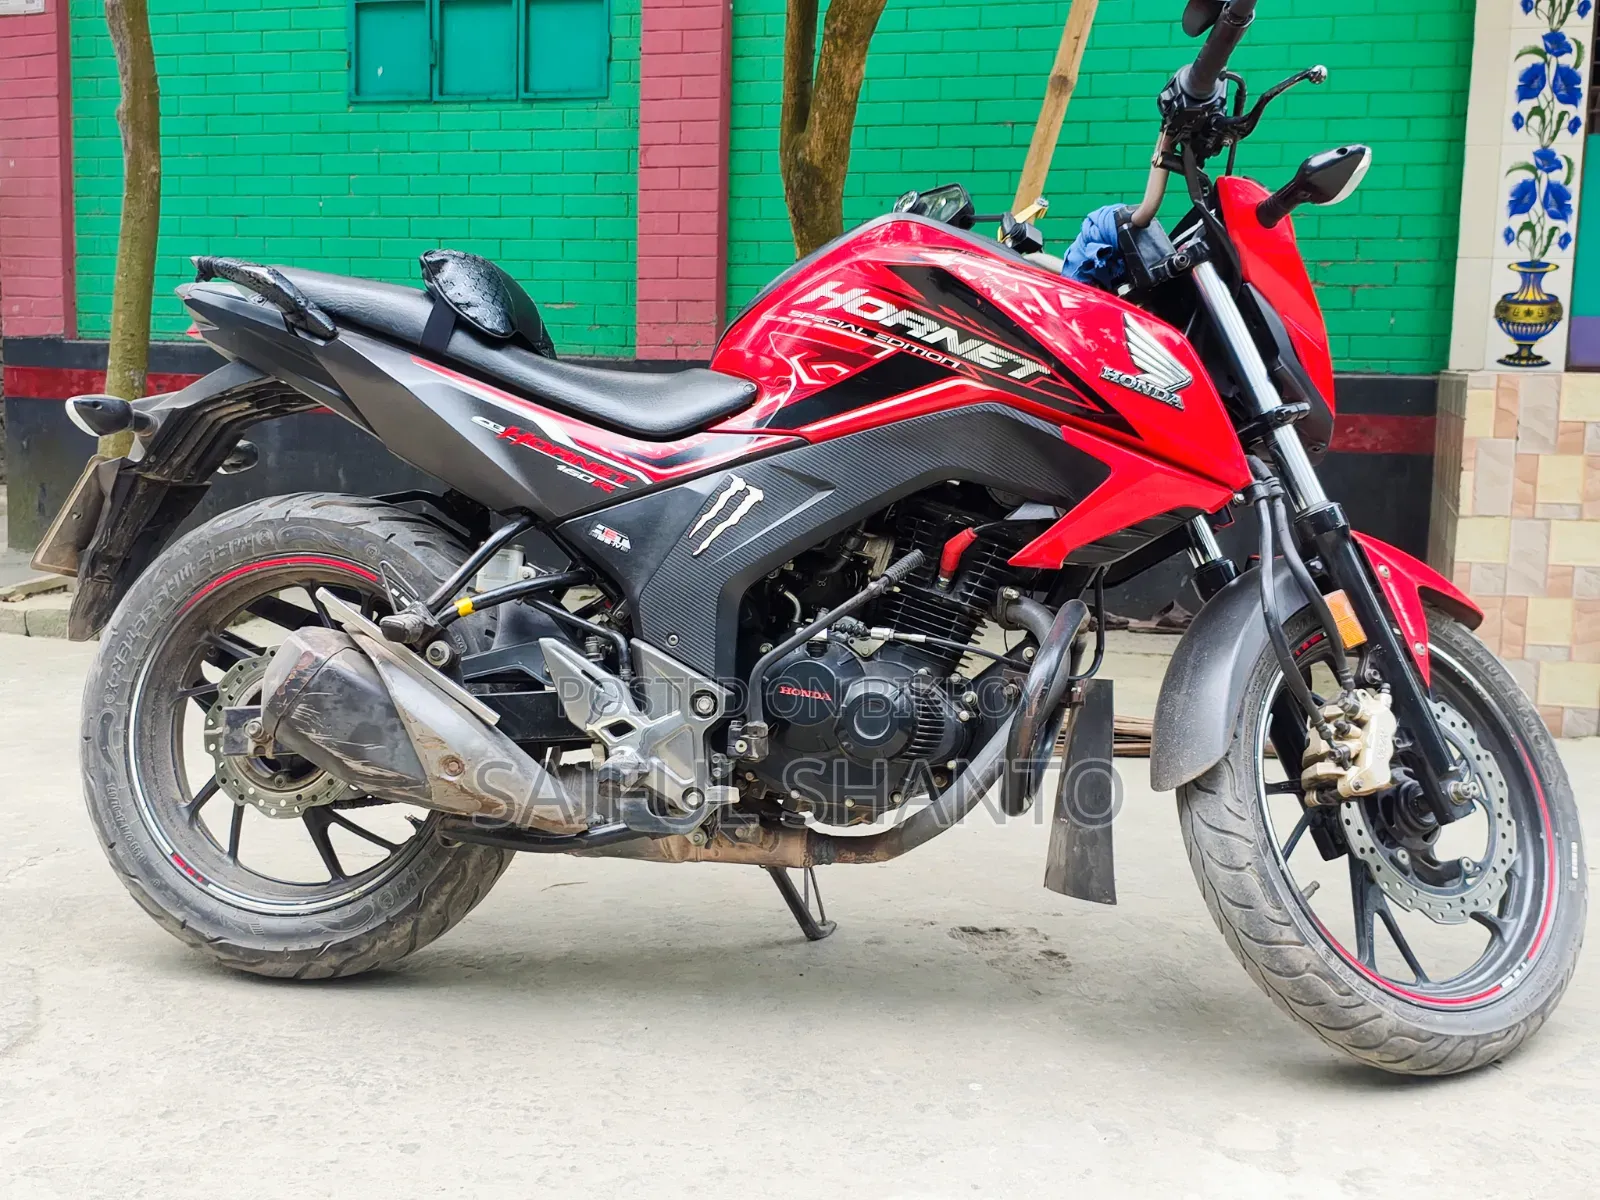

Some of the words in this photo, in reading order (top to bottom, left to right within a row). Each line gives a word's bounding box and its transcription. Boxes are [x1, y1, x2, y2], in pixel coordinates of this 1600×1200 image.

[788, 309, 868, 337] SPECIAL
[874, 333, 961, 368] EDITION
[793, 281, 1051, 379] HORNET
[1100, 366, 1185, 411] HONDA
[496, 425, 637, 485] HORNET
[556, 464, 617, 494] 160R
[779, 685, 832, 701] HONDA
